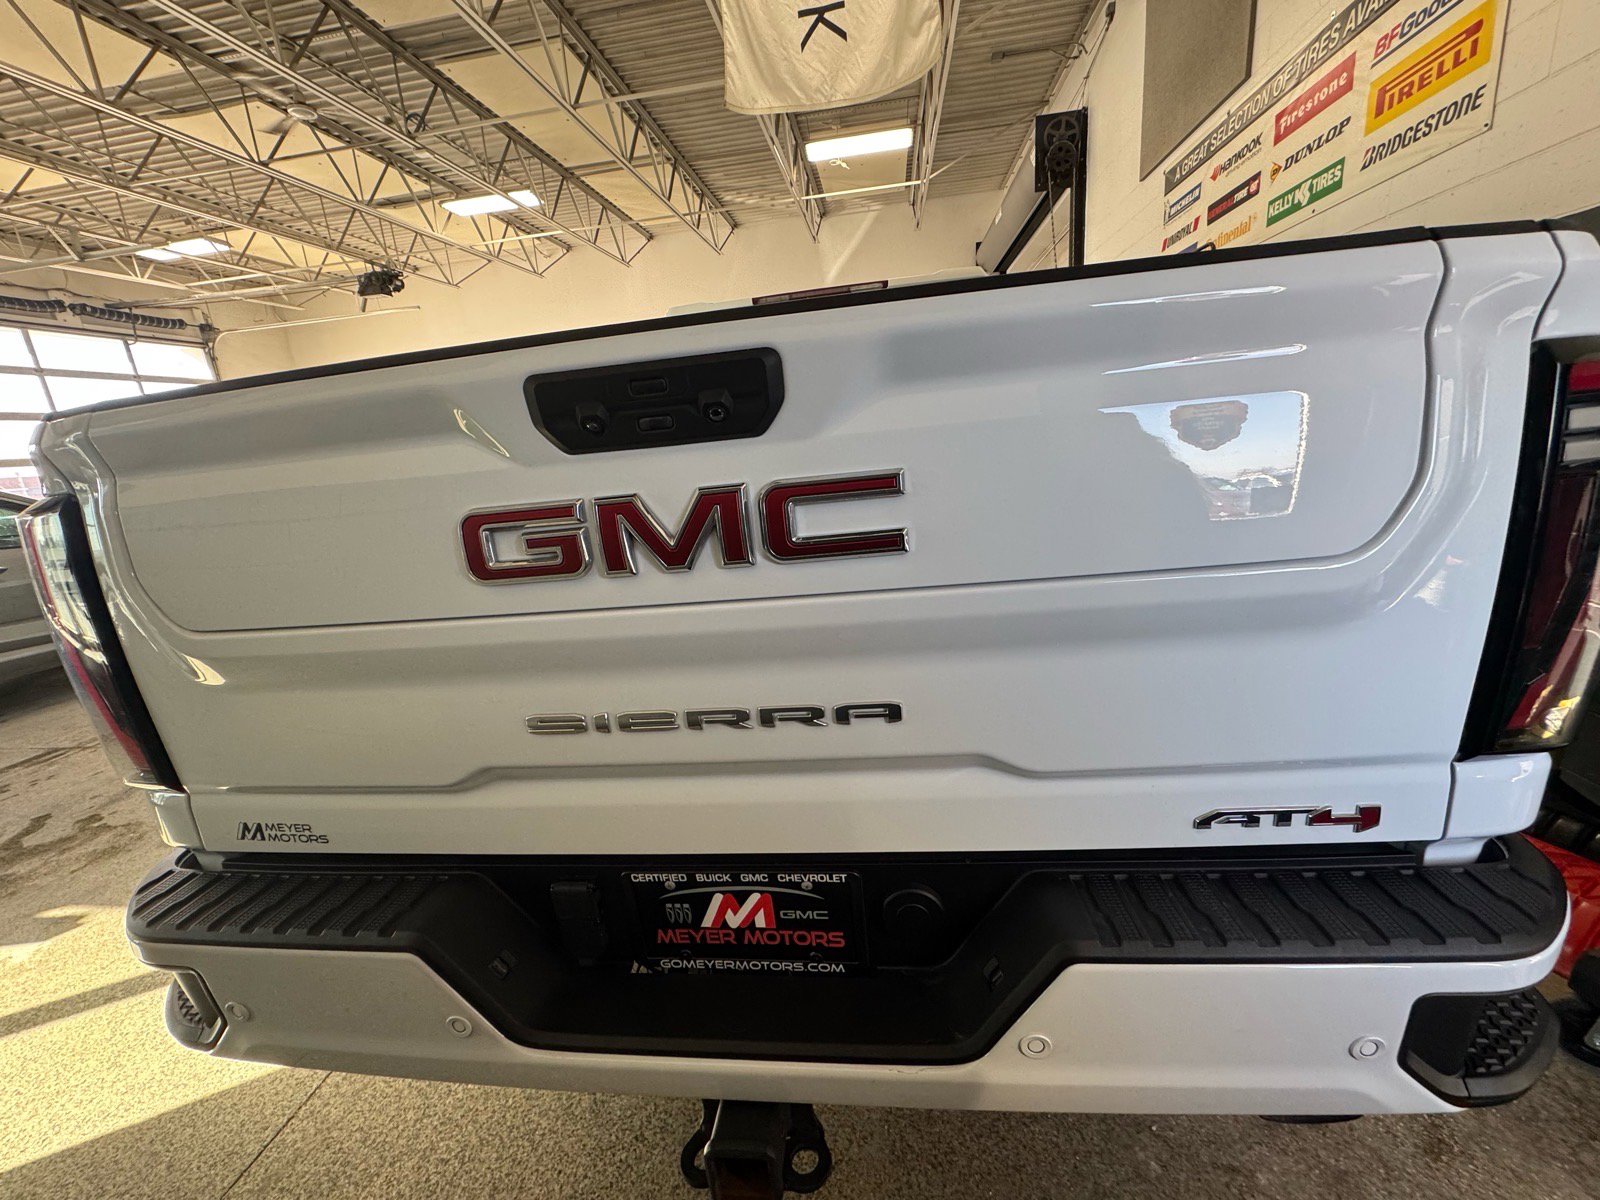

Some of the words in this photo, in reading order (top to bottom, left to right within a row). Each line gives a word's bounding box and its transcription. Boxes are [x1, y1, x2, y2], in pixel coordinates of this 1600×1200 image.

[1374, 18, 1484, 120] PIRELLI
[1174, 165, 1181, 182] A
[1182, 140, 1209, 176] GREAT
[1210, 85, 1271, 152] SELECTION
[1272, 65, 1293, 97] OF
[1293, 22, 1341, 80] TIRES
[1279, 71, 1348, 135] Firestone
[1360, 83, 1487, 172] BRIDGESTONE
[1282, 116, 1351, 172] DUNLOP
[1267, 190, 1295, 219] KELLY
[1312, 164, 1342, 194] TIRES
[459, 468, 909, 585] GMC
[525, 702, 902, 734] SIERRA
[265, 823, 312, 833] MEYER
[1193, 804, 1382, 833] AT4
[268, 833, 329, 844] MOTORS
[631, 873, 687, 883] CERTIFIED
[696, 873, 732, 882] BUICK
[740, 873, 769, 883] GMC
[777, 873, 847, 883] CHEVROLET
[780, 910, 829, 920] GMC
[657, 929, 737, 945] MEYER
[744, 930, 846, 948] MOTORS
[660, 959, 846, 973] GOMEYERMOTORS.COM
